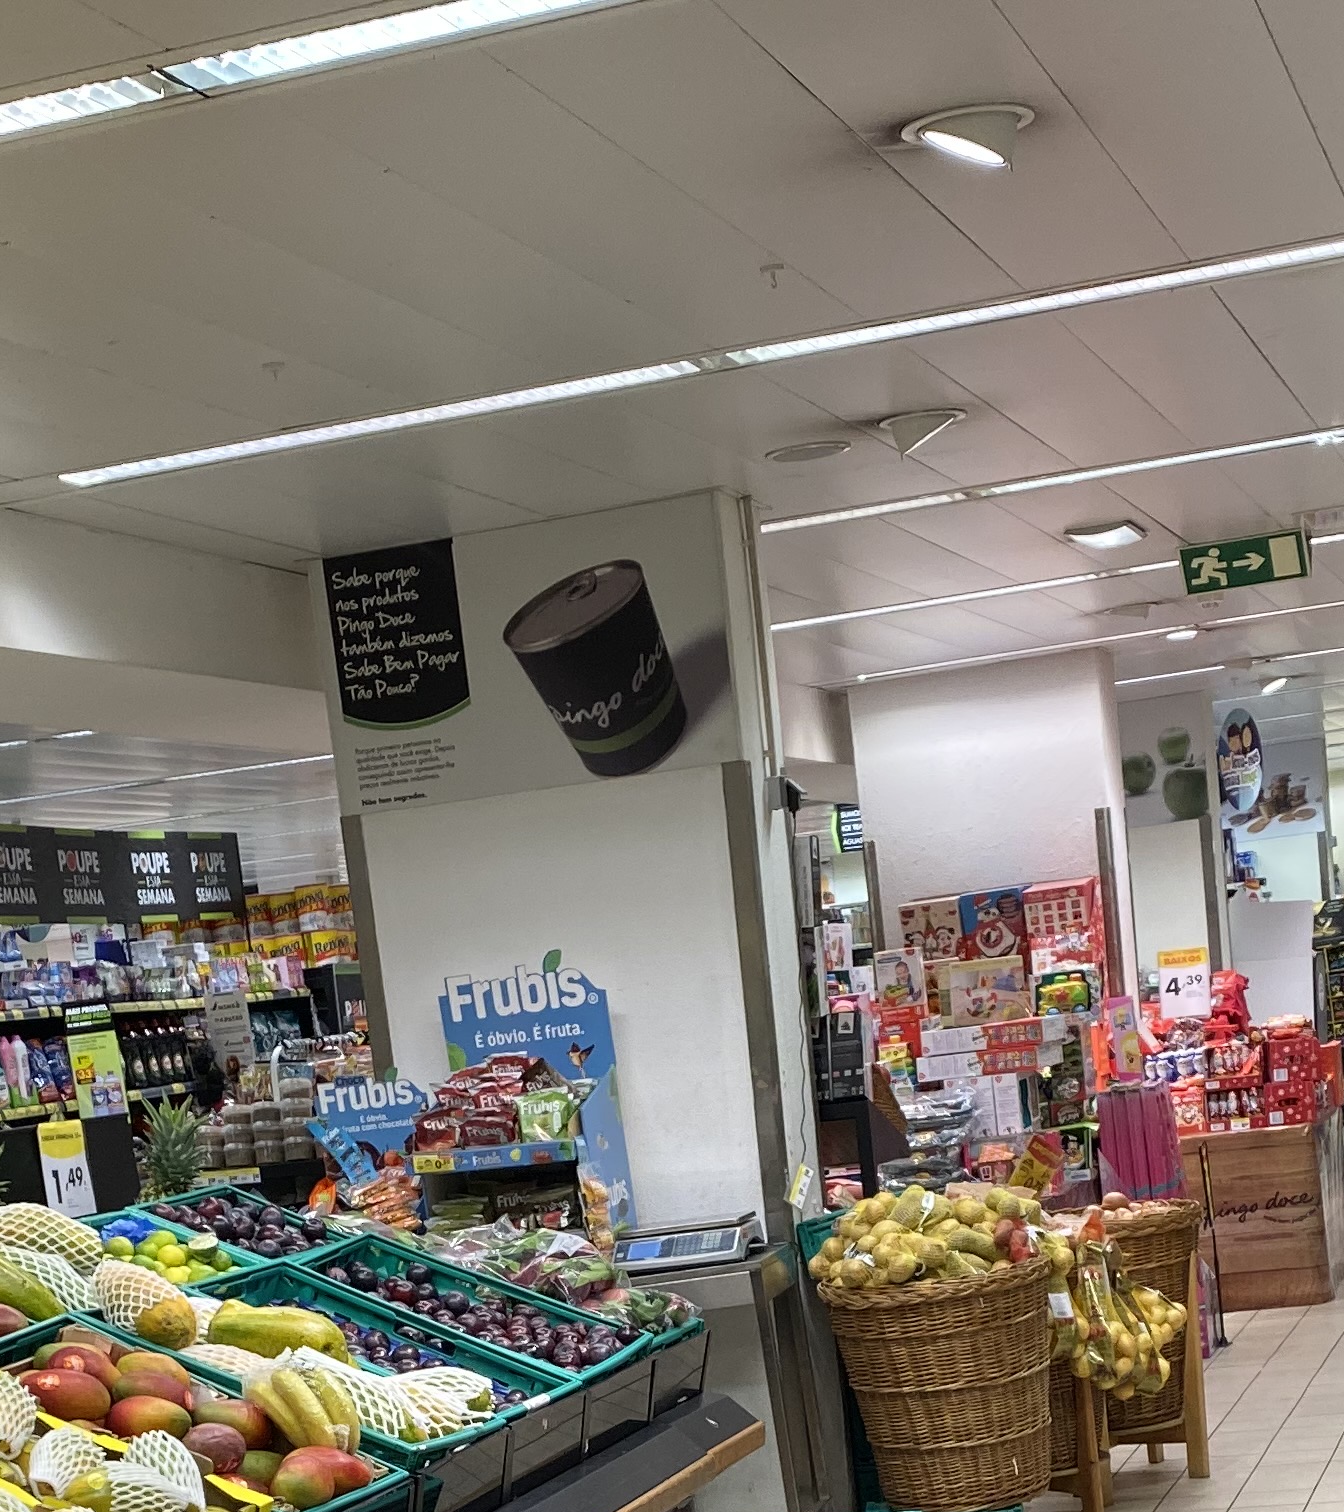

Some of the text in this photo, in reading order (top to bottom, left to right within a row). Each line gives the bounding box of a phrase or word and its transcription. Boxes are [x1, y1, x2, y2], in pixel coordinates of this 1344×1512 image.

[332, 566, 420, 589] Sabe porque
[336, 585, 419, 614] nos produtos
[337, 612, 416, 637] Pingo Doce
[341, 630, 453, 656] também dizemos
[344, 650, 460, 678] Sabe Bem Pagar
[345, 674, 419, 700] Tão Pouco?
[57, 849, 100, 873] POUPE
[130, 851, 170, 873] POUPE
[190, 851, 227, 873] POUPE
[63, 888, 105, 906] SEMANA
[136, 887, 175, 905] SEMANA
[196, 886, 232, 904] SEMANA
[445, 964, 586, 1022] Frubis
[1165, 975, 1202, 996] 4,39
[475, 1022, 585, 1048] É óbvio. É fruta.
[317, 1077, 415, 1114] Frubis
[51, 1167, 83, 1204] 1,49
[1266, 1191, 1309, 1209] doce
